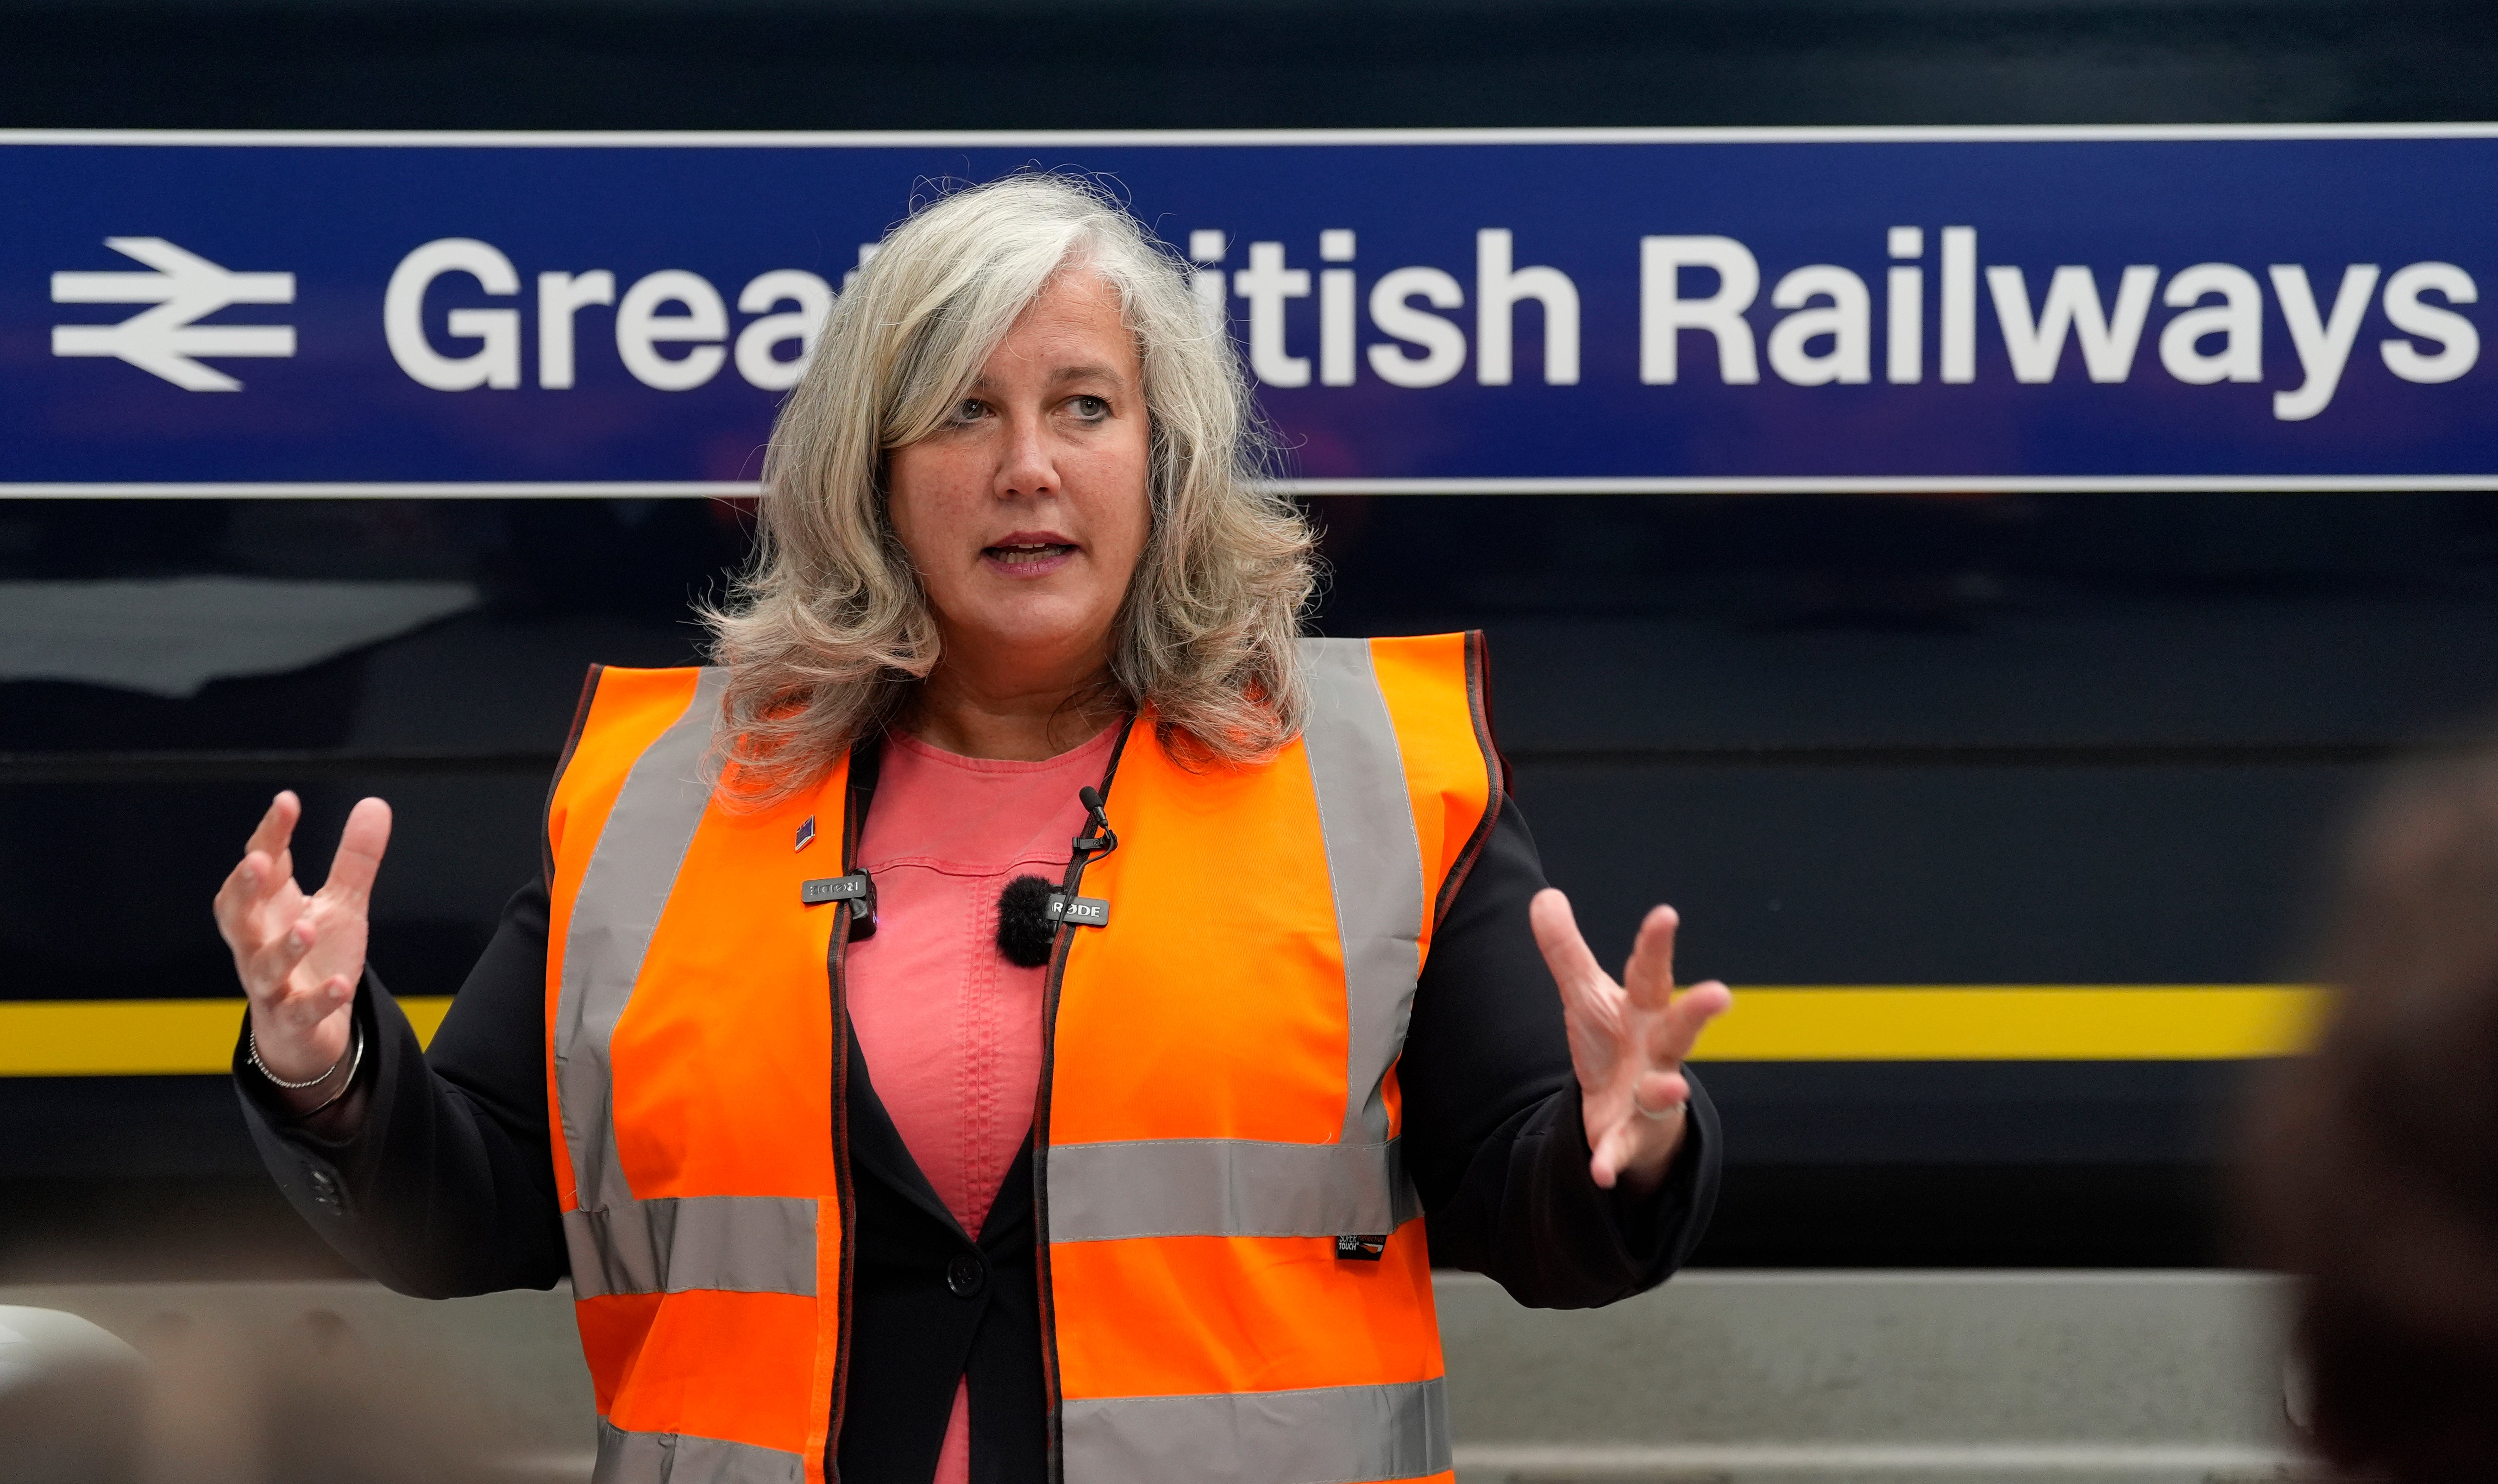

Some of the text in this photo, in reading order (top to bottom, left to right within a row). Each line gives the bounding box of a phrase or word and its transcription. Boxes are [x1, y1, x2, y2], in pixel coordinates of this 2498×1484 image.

[383, 225, 2480, 421] Grea itish Railways
[1051, 902, 1100, 917] RØDE
